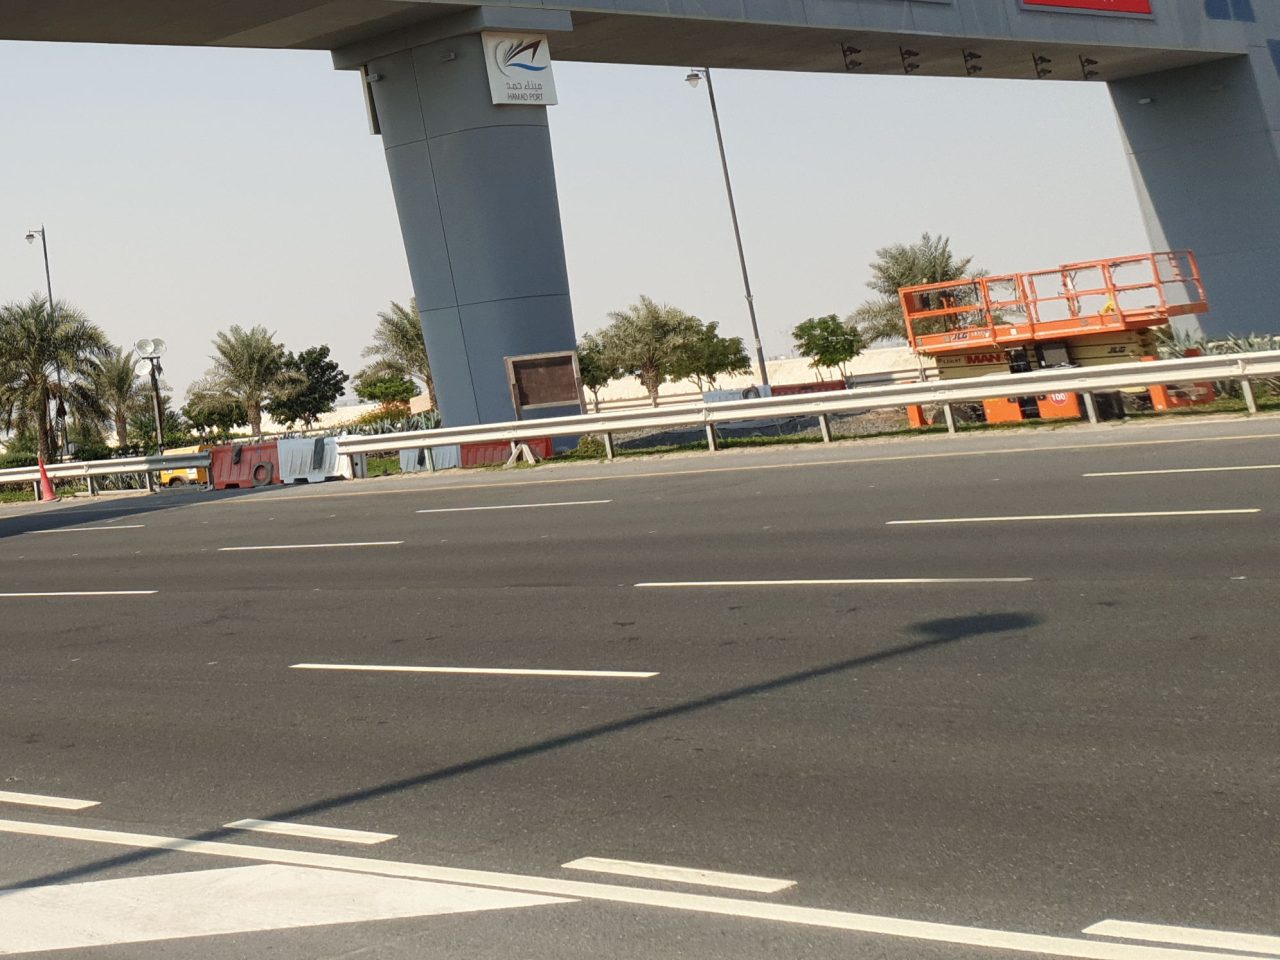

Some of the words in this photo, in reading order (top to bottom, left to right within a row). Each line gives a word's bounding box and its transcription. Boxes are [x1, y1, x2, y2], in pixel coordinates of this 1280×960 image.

[507, 92, 528, 101] HAMAD
[529, 92, 543, 101] PORT
[1107, 346, 1127, 354] JLG
[1050, 392, 1066, 401] 100
